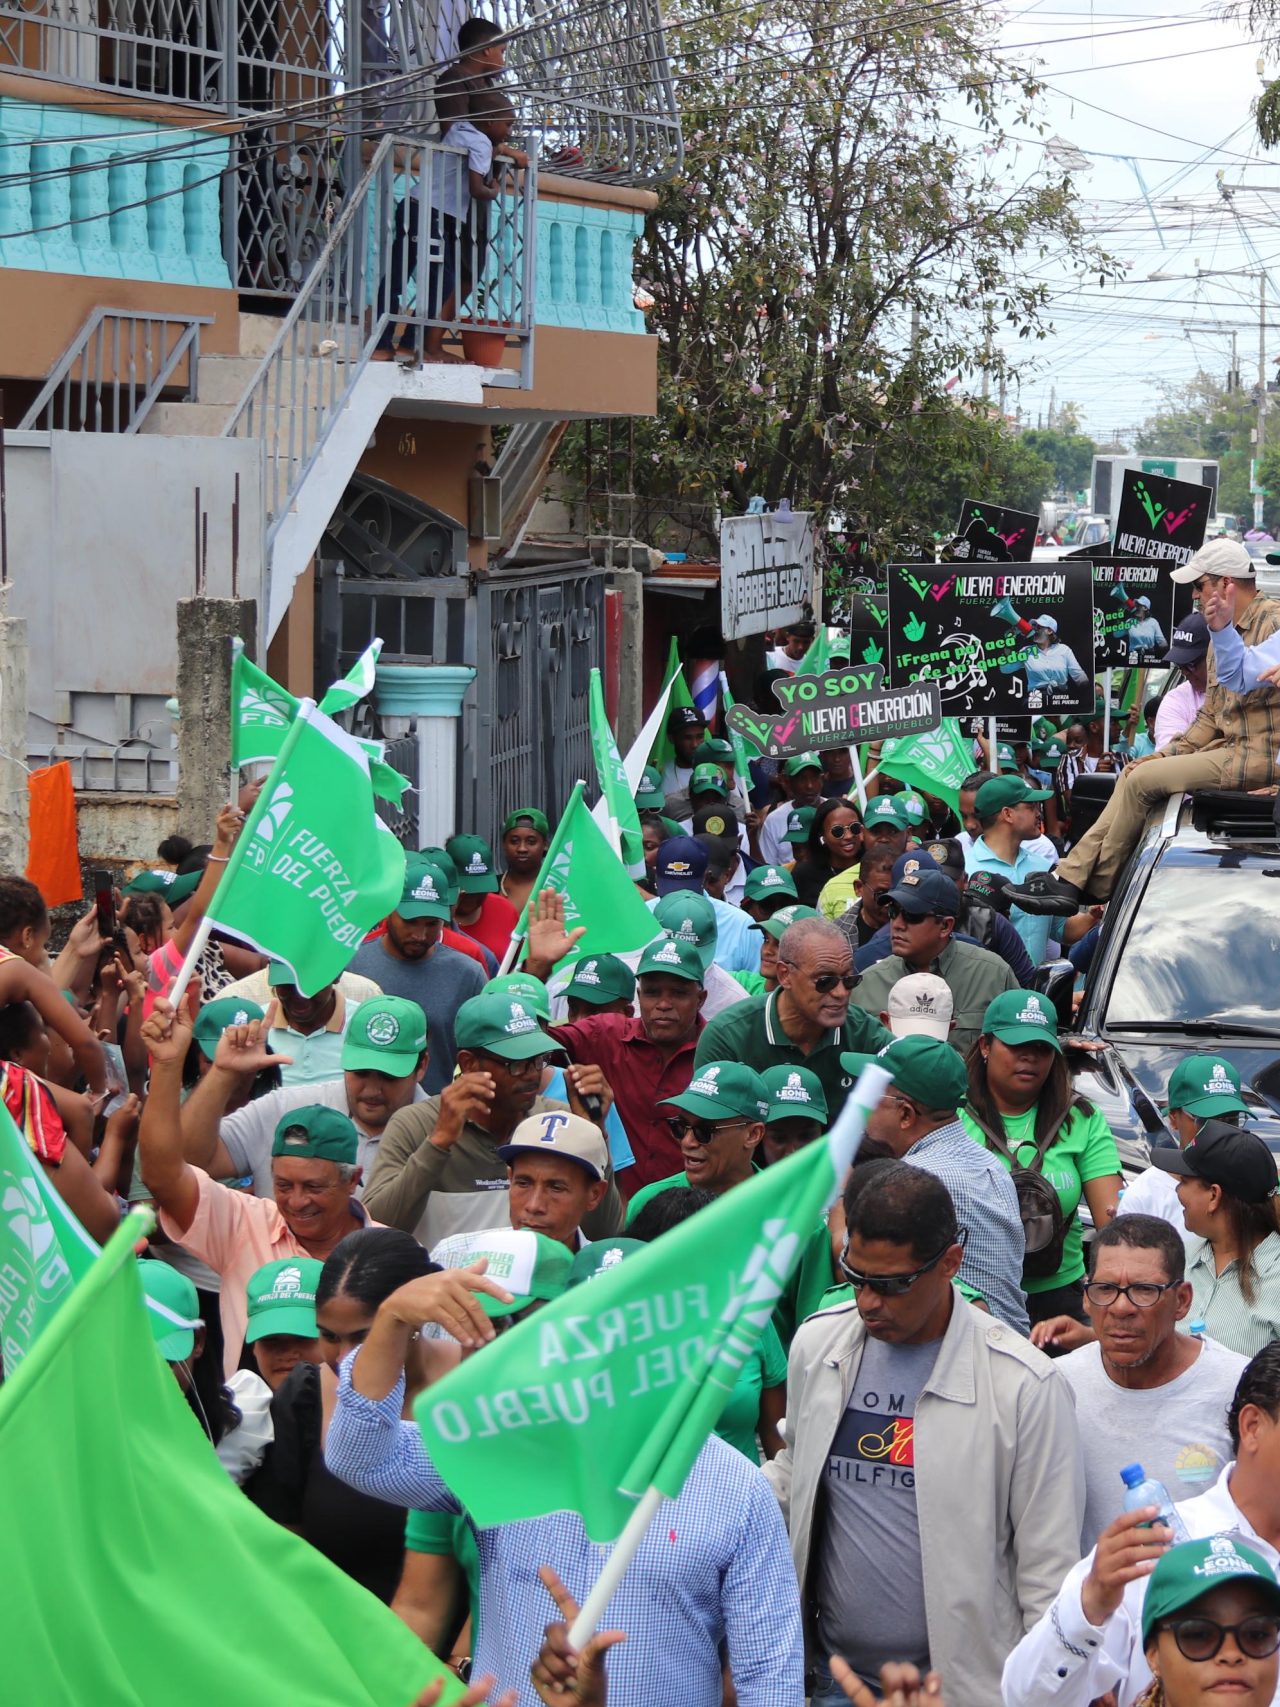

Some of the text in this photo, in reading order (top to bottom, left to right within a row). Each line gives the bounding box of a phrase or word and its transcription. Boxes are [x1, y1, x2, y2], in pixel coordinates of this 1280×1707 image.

[1118, 532, 1149, 554] NUEVA
[1114, 564, 1159, 583] GENERACIÓN
[955, 571, 1066, 597] NUEVA GENERACIÓN
[959, 597, 998, 605] FUERZA
[1025, 596, 1065, 604] PUEBLO
[896, 650, 950, 669] ¡Frena
[923, 665, 942, 680] te
[779, 671, 876, 704] YO SOY
[802, 689, 933, 737] NUEVA GENERACIÓN
[809, 717, 933, 745] FUERZA DEL PUEBLO
[908, 747, 937, 773] FP
[271, 853, 312, 889] DEL
[289, 829, 360, 907] FUERZA
[411, 888, 440, 899] LEONEL
[574, 973, 601, 984] LEONEL
[909, 1004, 937, 1015] adidas
[1015, 1011, 1048, 1024] LEONEL
[505, 1019, 537, 1033] LEONEL
[690, 1079, 720, 1096] LEONEL
[776, 1089, 811, 1102] LEONEL
[1203, 1082, 1237, 1093] LEONEL
[540, 1113, 569, 1143] T
[828, 1458, 915, 1487] HILFIG
[1194, 1558, 1254, 1577] LEONEL
